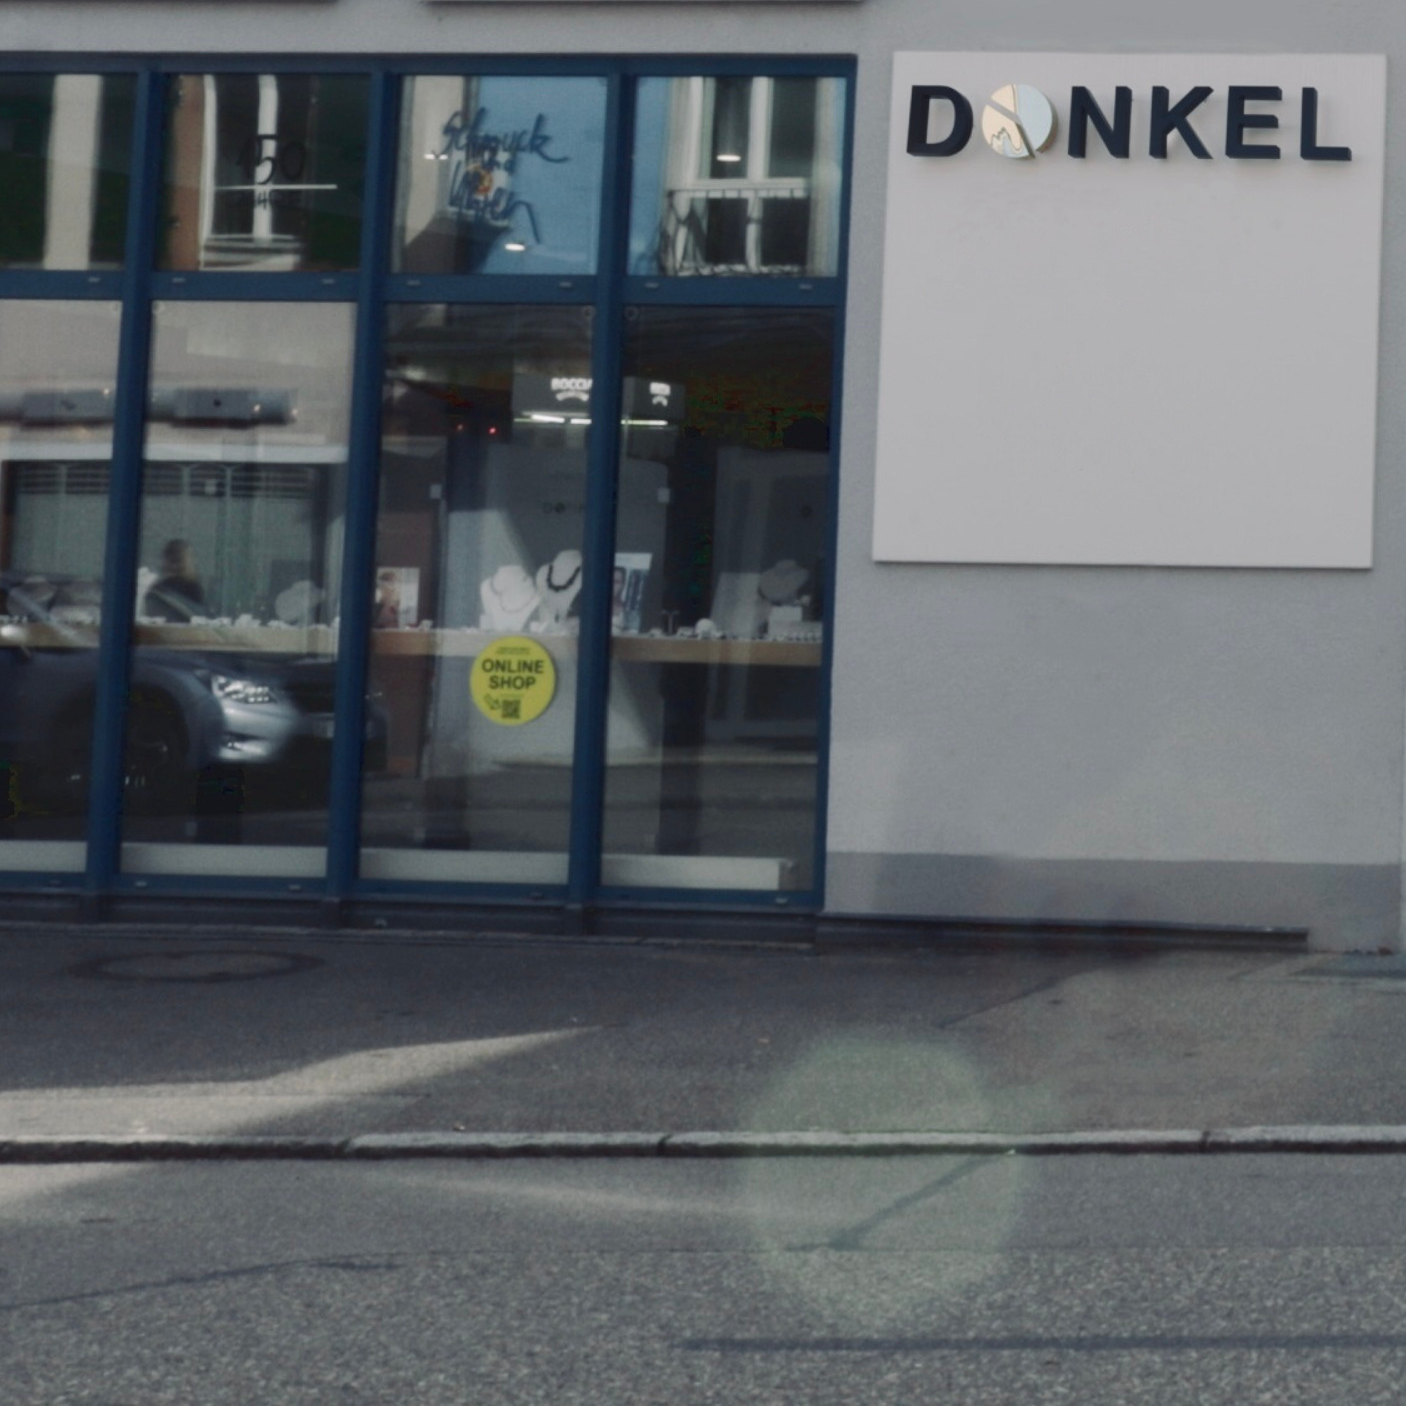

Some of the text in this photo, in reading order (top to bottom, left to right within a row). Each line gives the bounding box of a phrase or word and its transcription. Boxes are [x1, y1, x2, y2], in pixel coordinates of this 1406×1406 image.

[433, 106, 569, 164] Schmuck
[481, 658, 544, 674] ONLINE
[489, 675, 536, 690] SHOP
